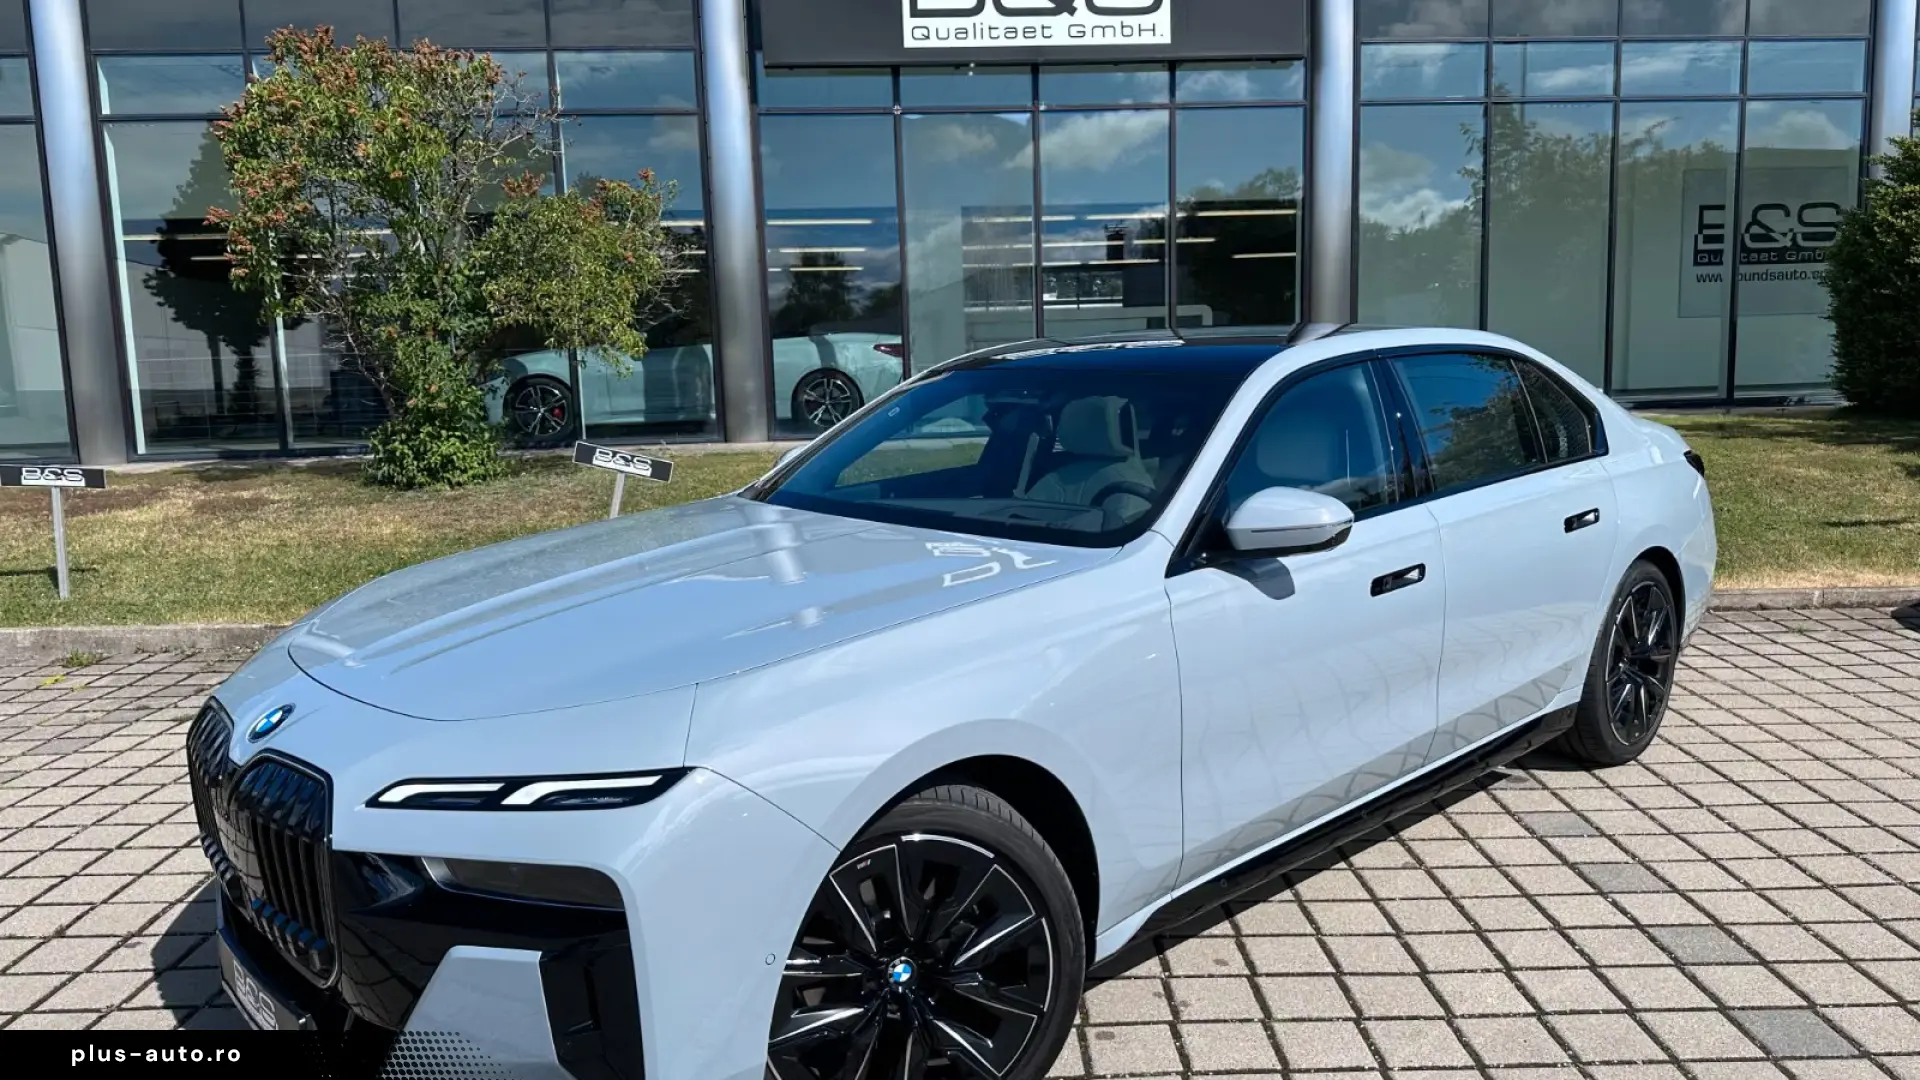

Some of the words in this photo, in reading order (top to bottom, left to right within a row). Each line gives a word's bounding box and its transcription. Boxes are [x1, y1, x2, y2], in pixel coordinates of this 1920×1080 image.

[911, 22, 1053, 41] Qualitaet
[1697, 250, 1778, 264] Qutaet
[1785, 249, 1826, 261] Gmb
[594, 448, 653, 471] B&S
[21, 467, 84, 482] B&S
